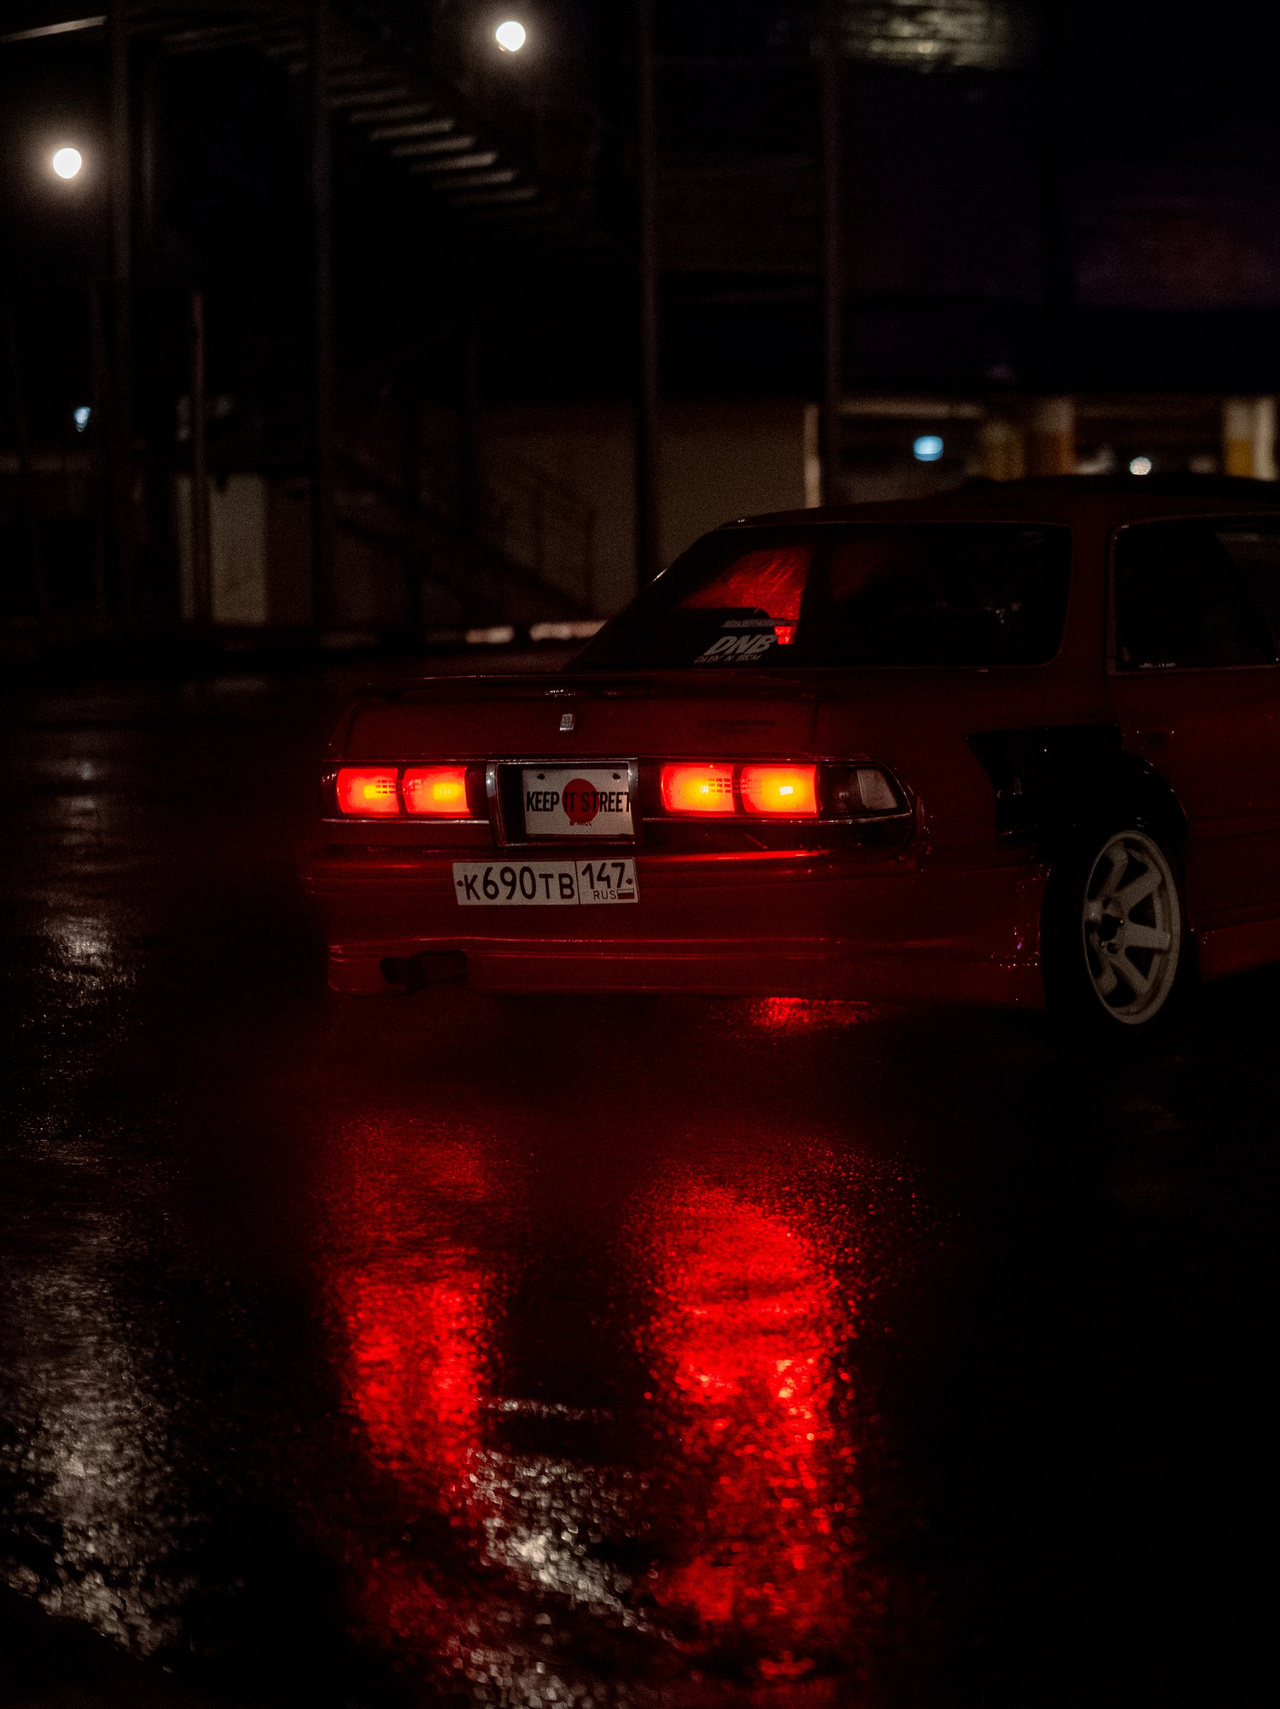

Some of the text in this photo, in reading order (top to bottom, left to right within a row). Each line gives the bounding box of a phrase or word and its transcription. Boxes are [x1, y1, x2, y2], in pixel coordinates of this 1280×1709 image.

[703, 634, 778, 655] DNB
[525, 791, 630, 812] KEEP IT STREET
[464, 862, 626, 900] K690TB 147
[593, 890, 617, 900] RUS
